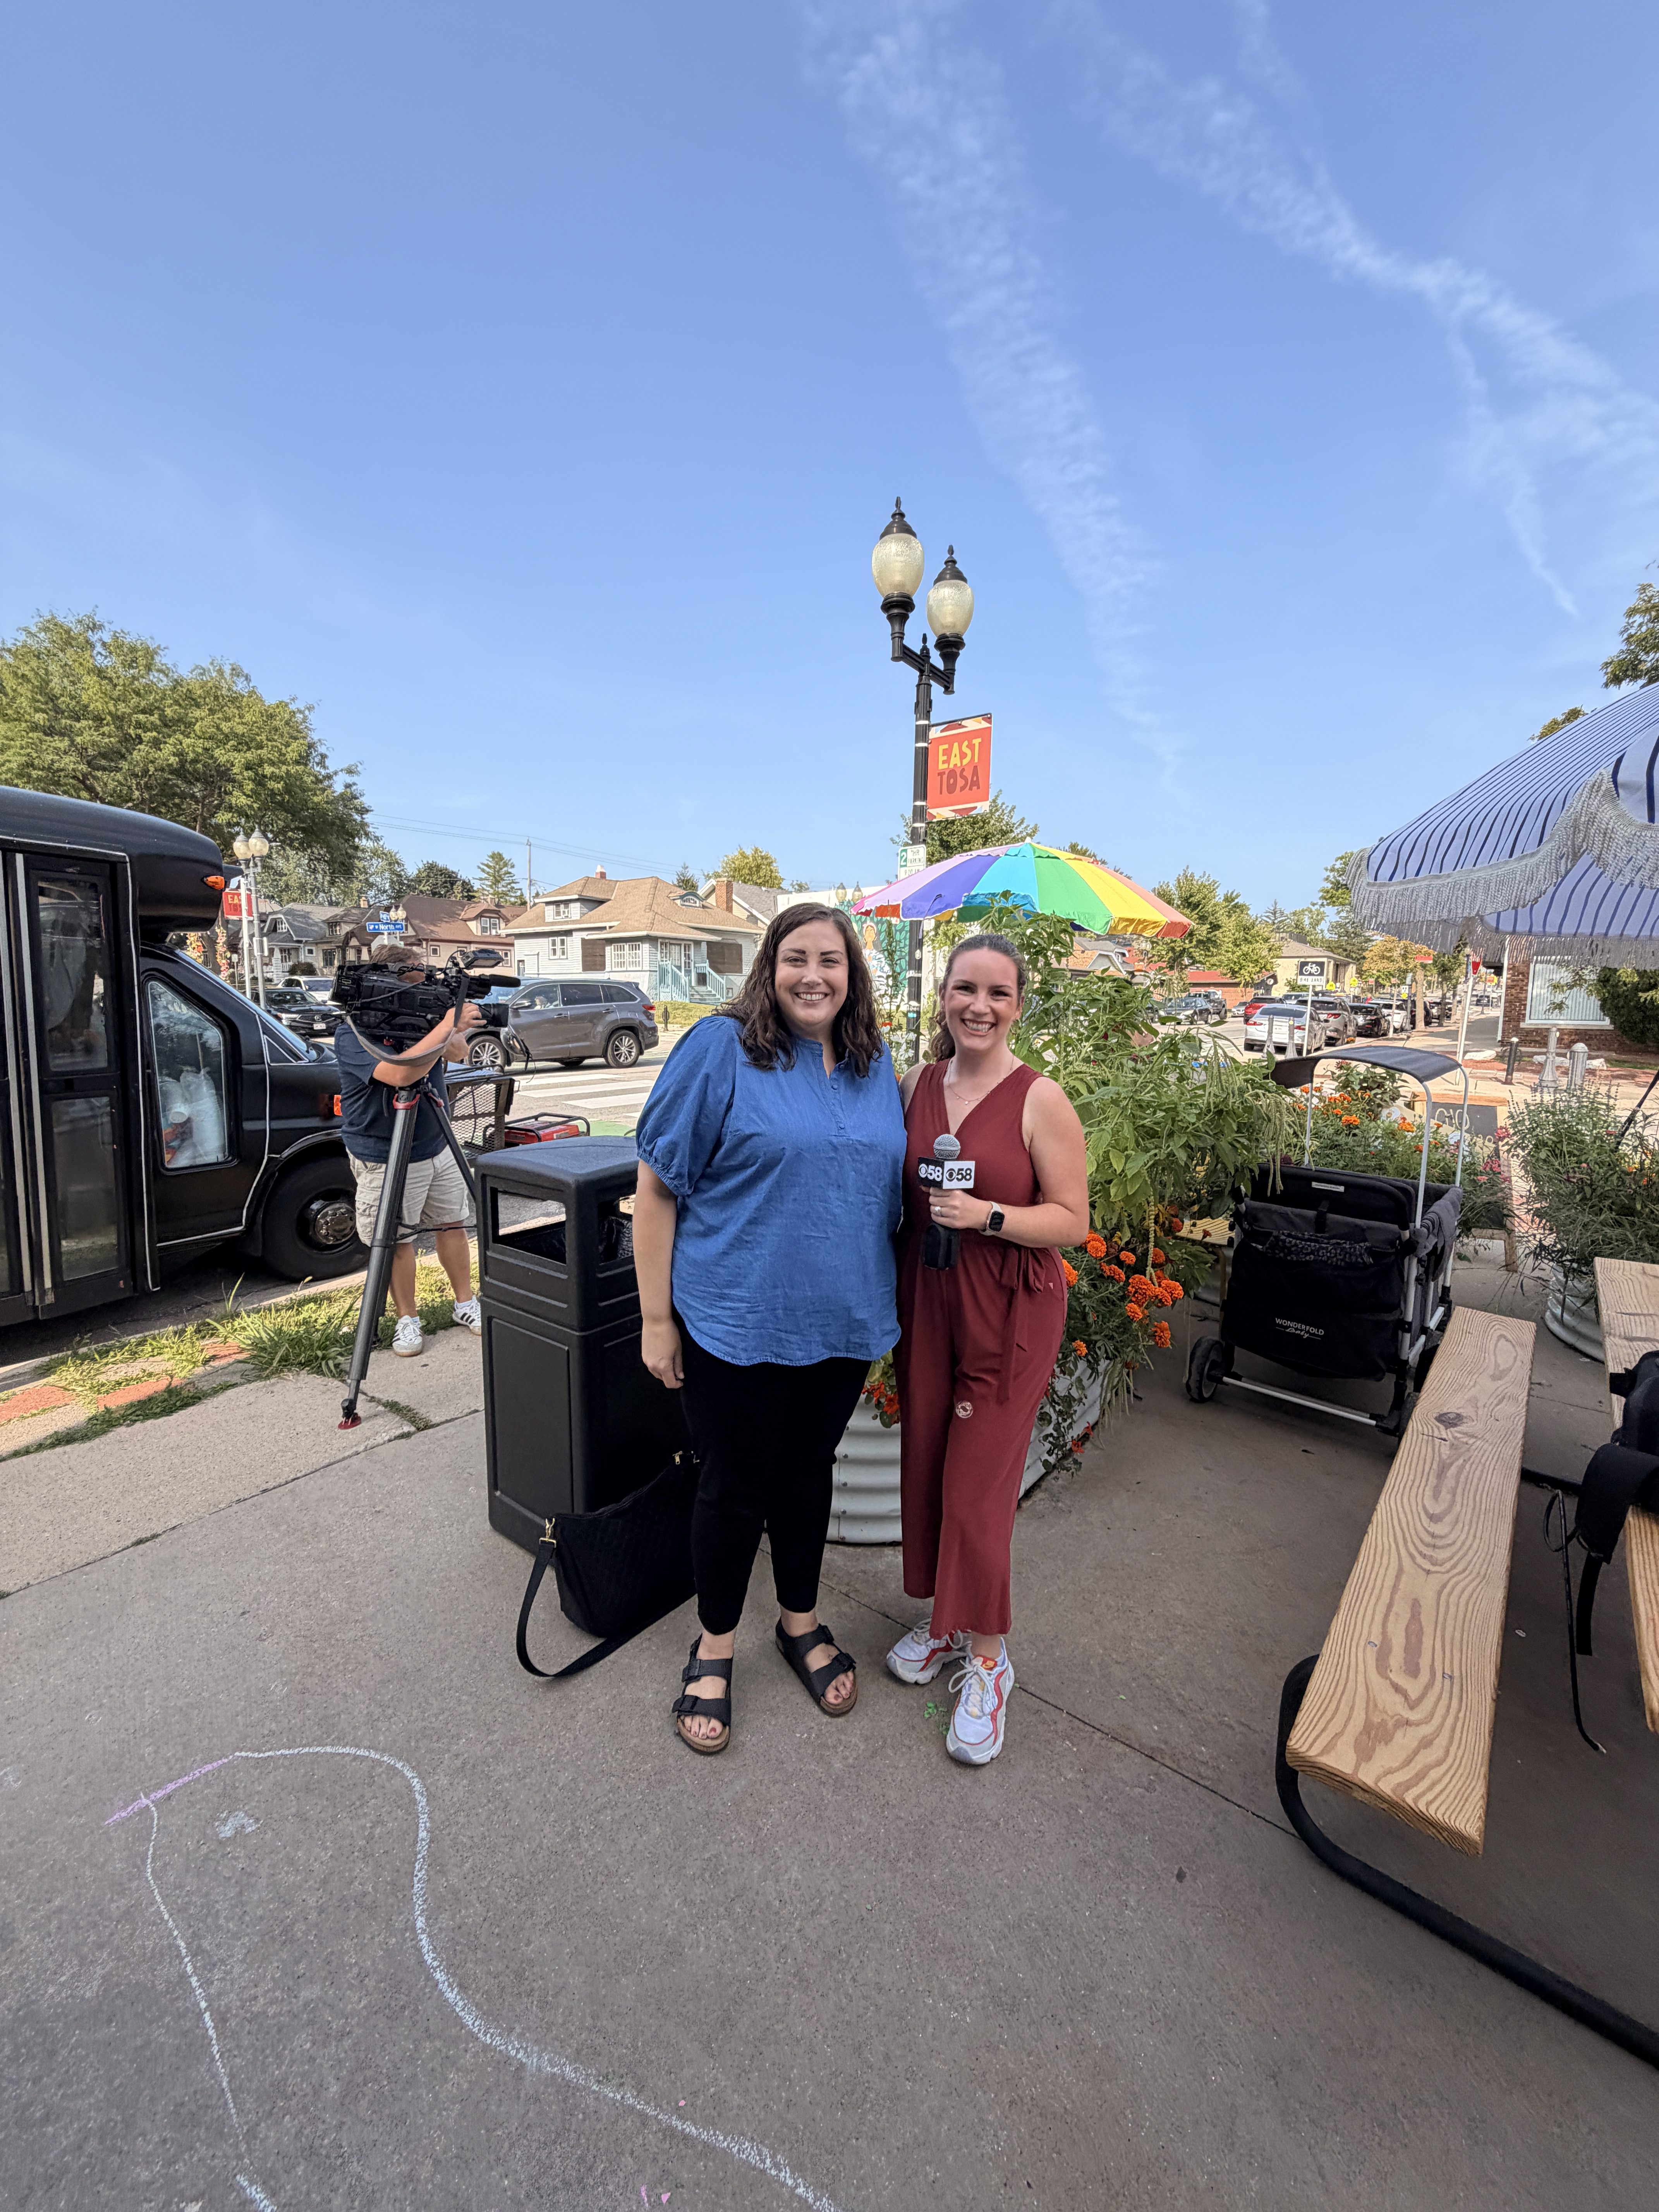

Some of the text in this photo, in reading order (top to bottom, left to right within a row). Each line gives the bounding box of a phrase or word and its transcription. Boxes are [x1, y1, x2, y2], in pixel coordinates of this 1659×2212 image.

[938, 738, 982, 770] EAST
[938, 765, 980, 795] TOSA
[900, 852, 907, 865] 2
[927, 1165, 942, 1181] 58
[956, 1168, 972, 1182] 58
[1275, 1317, 1324, 1335] WONDERFOLD
